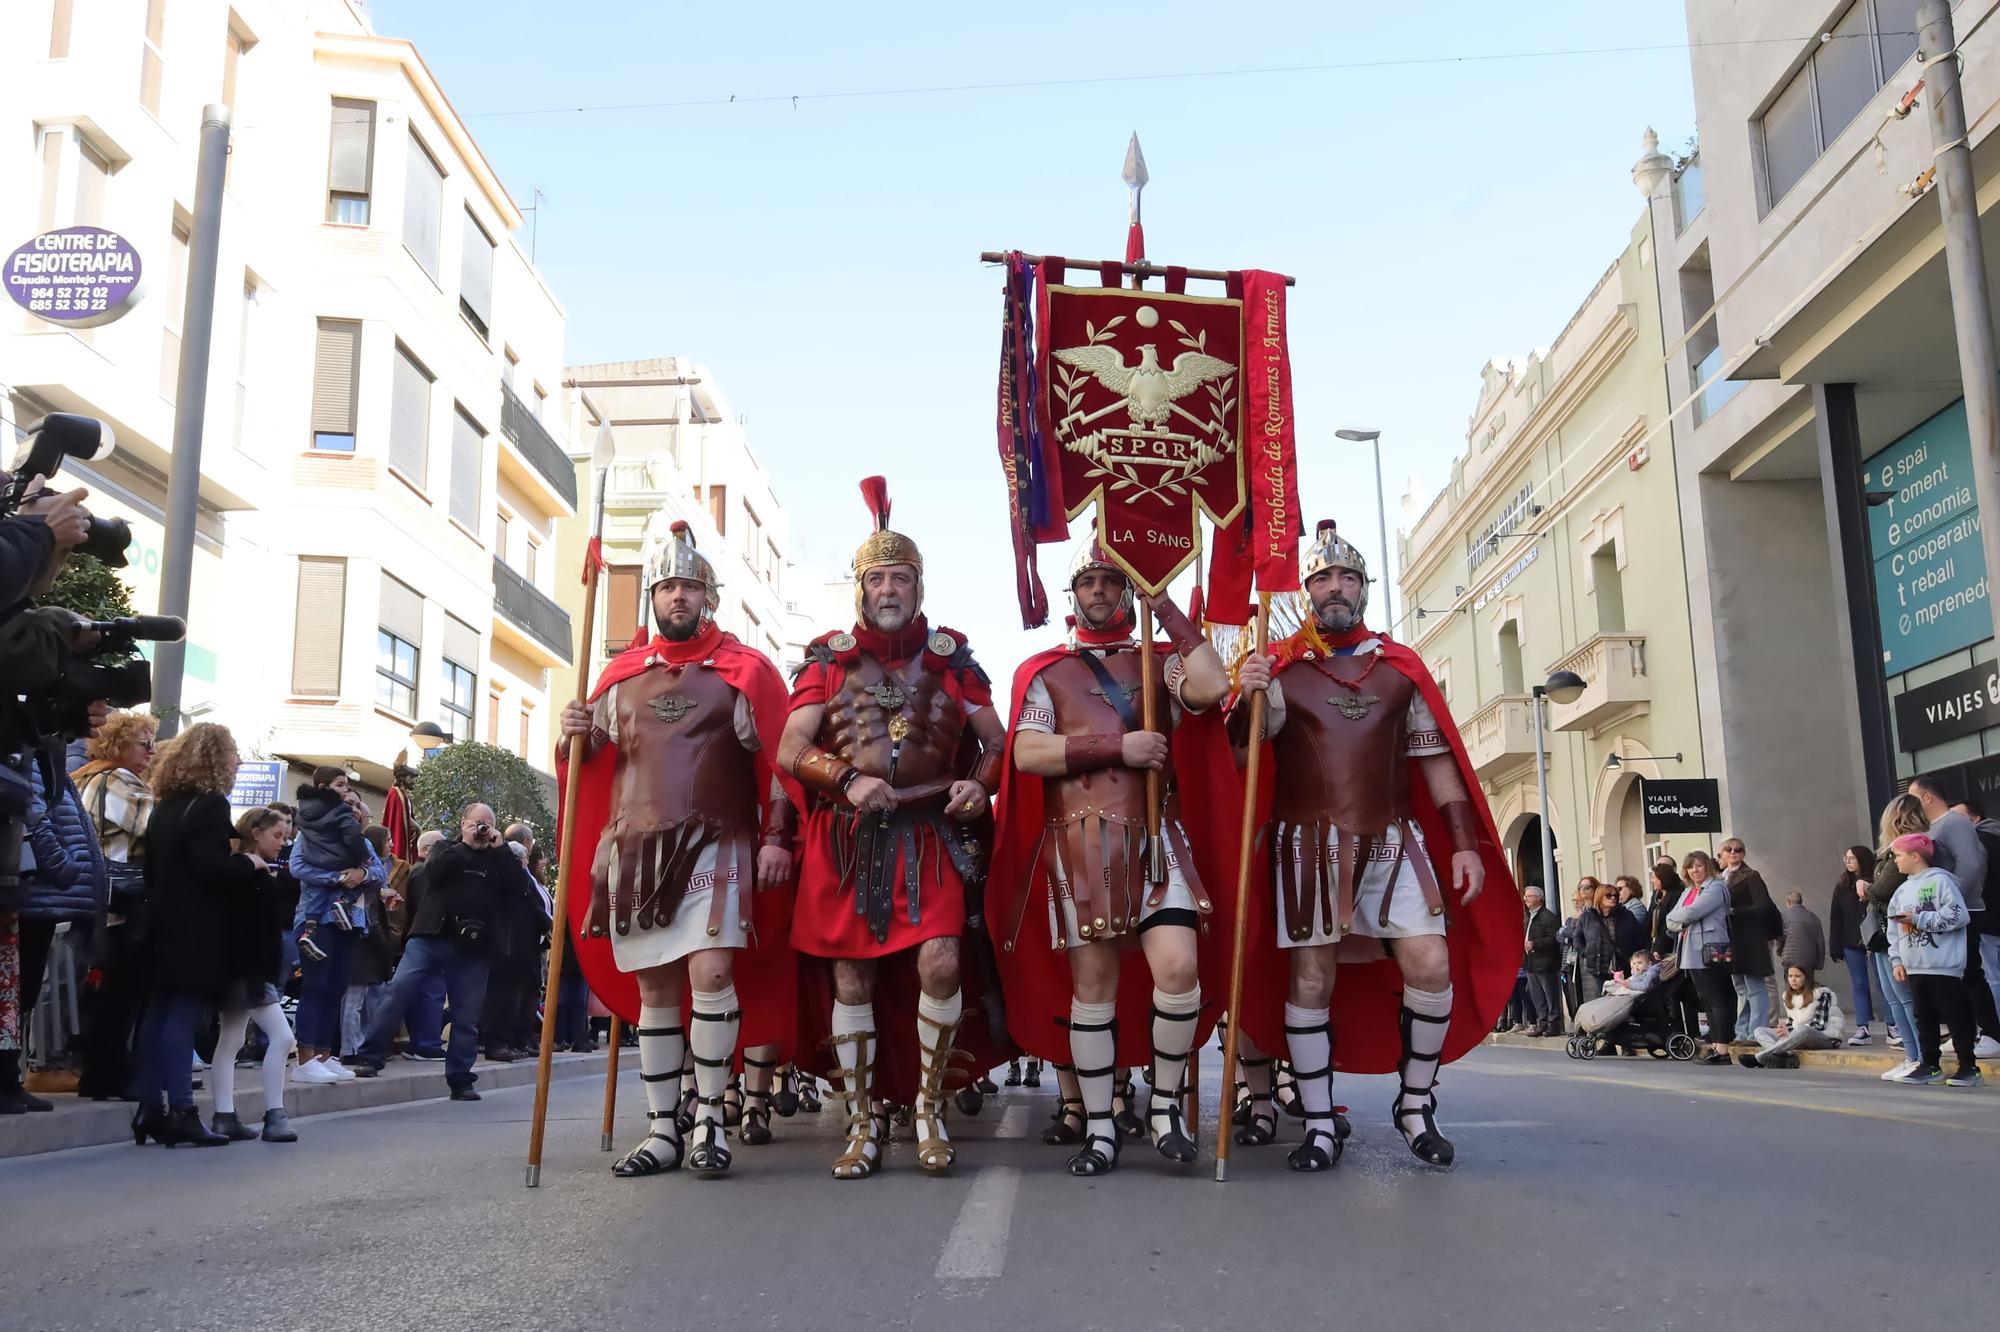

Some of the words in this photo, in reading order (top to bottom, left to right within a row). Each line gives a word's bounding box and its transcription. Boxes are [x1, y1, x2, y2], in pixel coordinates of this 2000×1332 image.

[35, 234, 94, 250] CENTRE
[96, 234, 117, 250] DE
[13, 252, 134, 273] FISIOTERAPIA
[10, 275, 51, 285] Claudio
[53, 275, 96, 285] Montejo
[98, 275, 134, 284] Ferrer
[31, 288, 54, 299] 964
[57, 288, 72, 298] 52
[75, 287, 90, 298] 72
[93, 287, 108, 298] 02
[29, 299, 52, 311] 685
[55, 299, 70, 310] 52
[73, 299, 88, 310] 39
[91, 299, 106, 310] 22
[1263, 288, 1282, 353] Armats
[1264, 354, 1281, 362] i
[1264, 366, 1285, 437] Romans
[1263, 441, 1282, 461] de
[1897, 441, 1928, 475] spai
[1901, 462, 1948, 504] oment
[1265, 465, 1286, 539] Trobada
[1904, 487, 1971, 534] conomia
[1113, 529, 1135, 543] LA
[1146, 529, 1191, 549] SANG
[1912, 558, 1956, 596] reball
[1926, 689, 1984, 724] VIAJES
